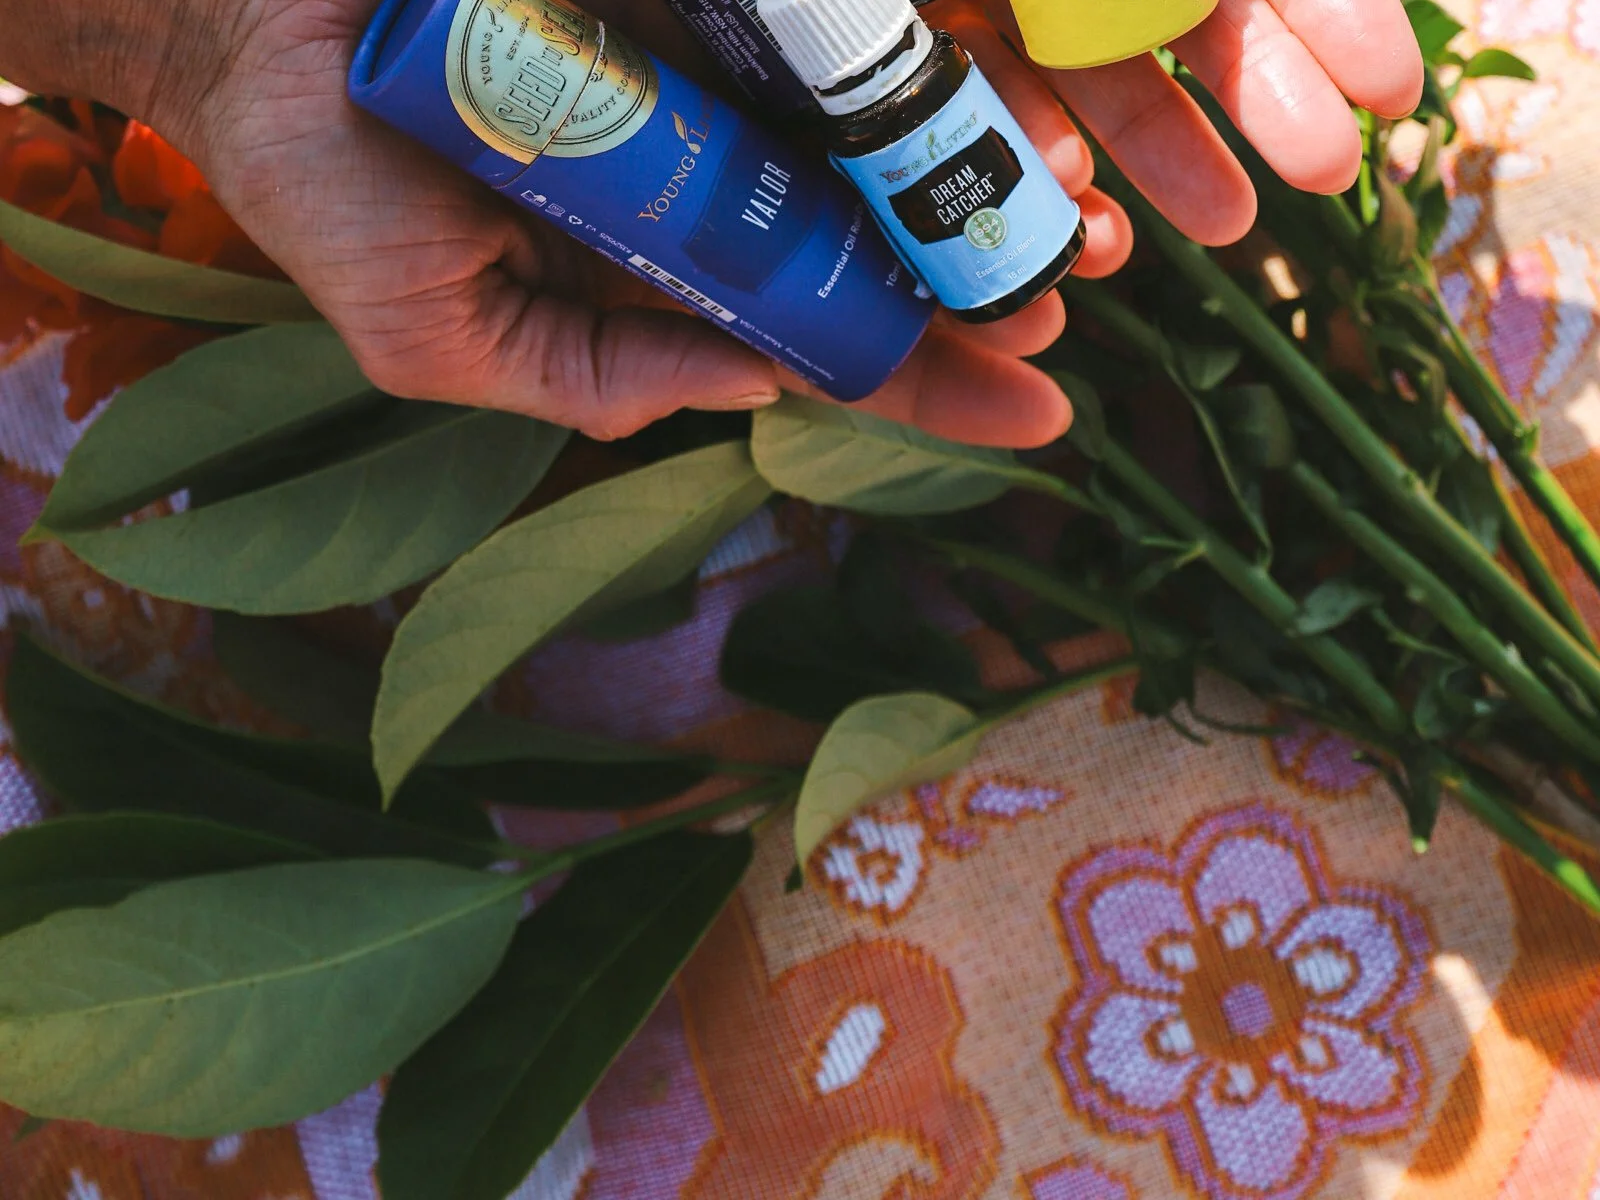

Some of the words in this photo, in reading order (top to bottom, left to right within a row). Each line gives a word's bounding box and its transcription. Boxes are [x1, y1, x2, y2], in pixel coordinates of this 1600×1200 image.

[699, 11, 718, 32] Court
[722, 10, 739, 28] USA
[735, 26, 745, 35] in
[480, 32, 493, 85] YOUNG
[715, 31, 744, 65] Columbia
[740, 32, 760, 54] Made
[738, 45, 769, 80] Baulkham
[493, 55, 568, 136] SEED
[541, 45, 564, 66] TO
[563, 95, 617, 127] UALITY
[934, 110, 977, 156] LIVING
[637, 155, 697, 222] YOUNG
[741, 161, 792, 230] VALOR
[930, 164, 978, 206] DREAM
[972, 217, 999, 240] 1994
[817, 251, 850, 299] Essential
[844, 234, 857, 251] Oil
[975, 257, 1008, 279] Essential
[1006, 249, 1018, 261] Oil
[1016, 234, 1036, 254] Blend
[1017, 264, 1027, 275] ml
